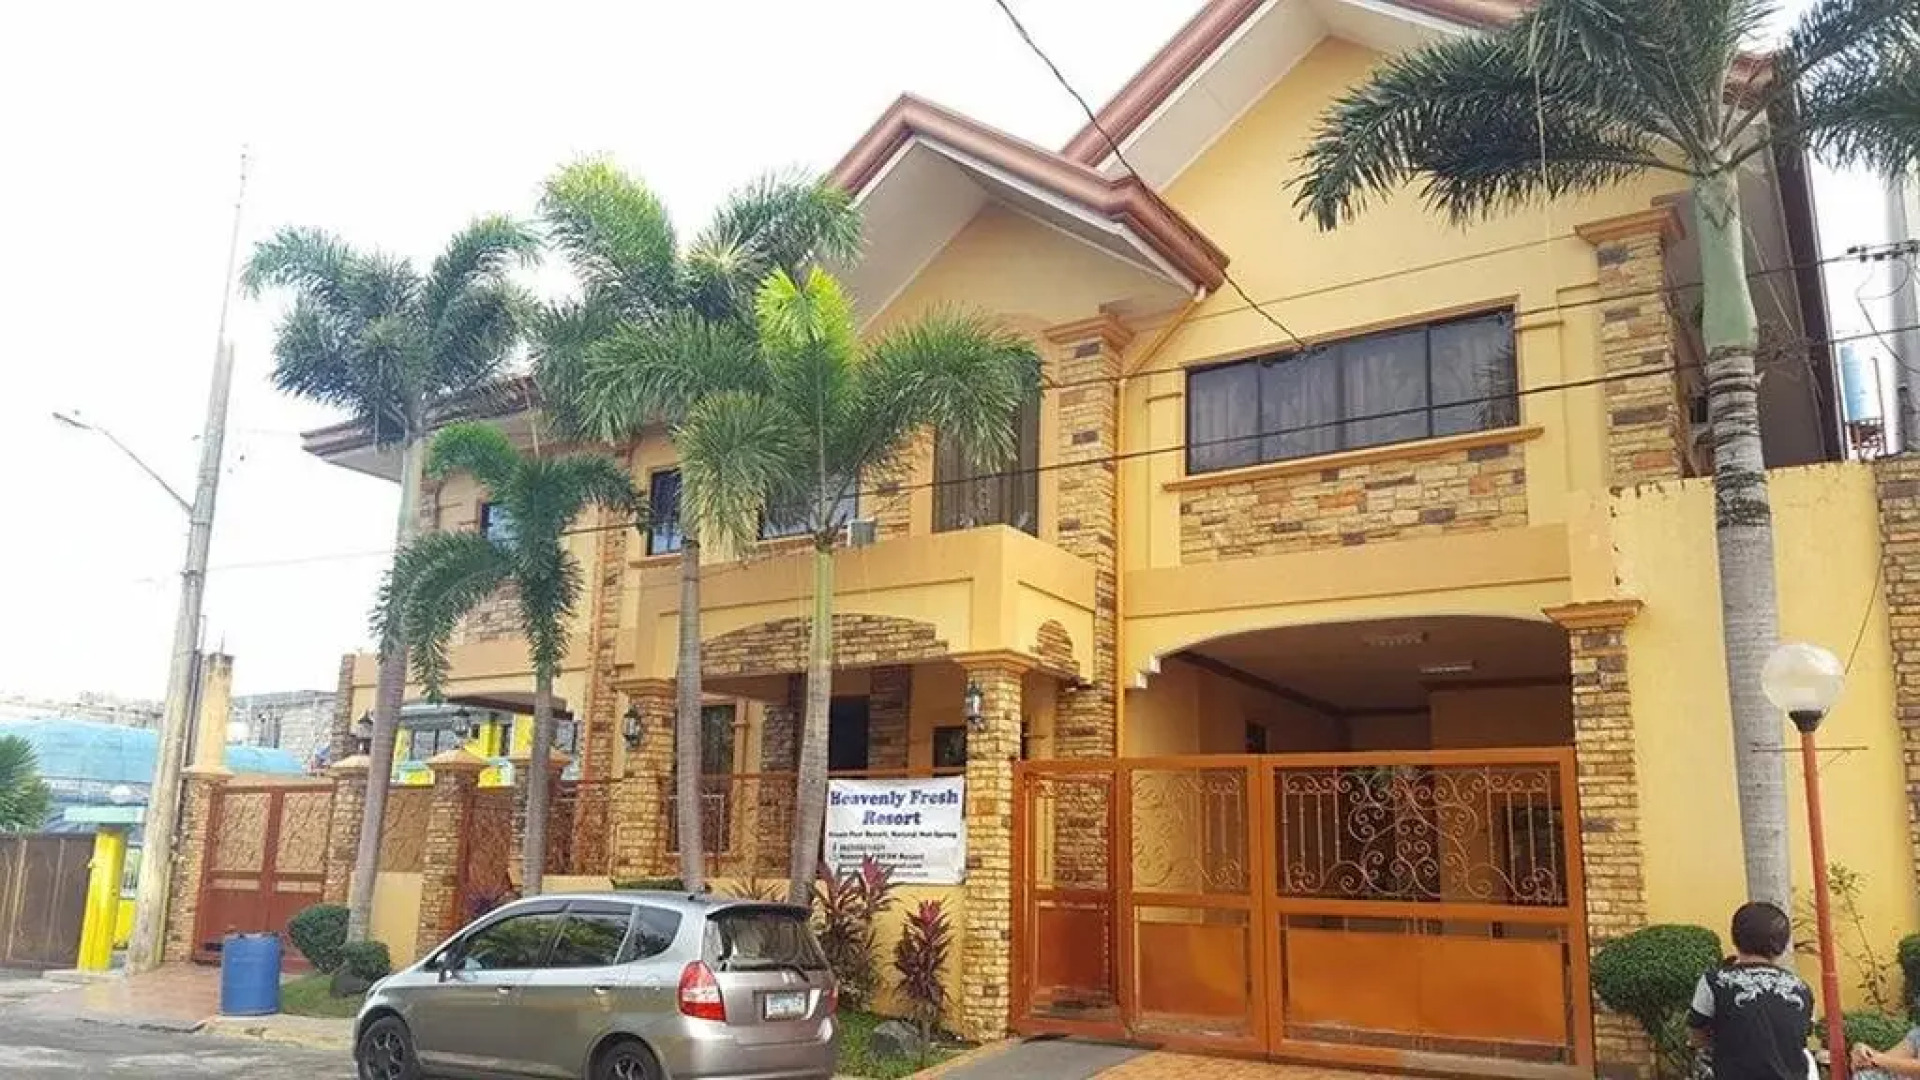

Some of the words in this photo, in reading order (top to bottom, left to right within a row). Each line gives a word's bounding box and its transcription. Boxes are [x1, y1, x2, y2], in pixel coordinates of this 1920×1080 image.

[830, 790, 906, 808] Heavenly
[909, 789, 959, 805] Fresh
[862, 810, 921, 825] Resort
